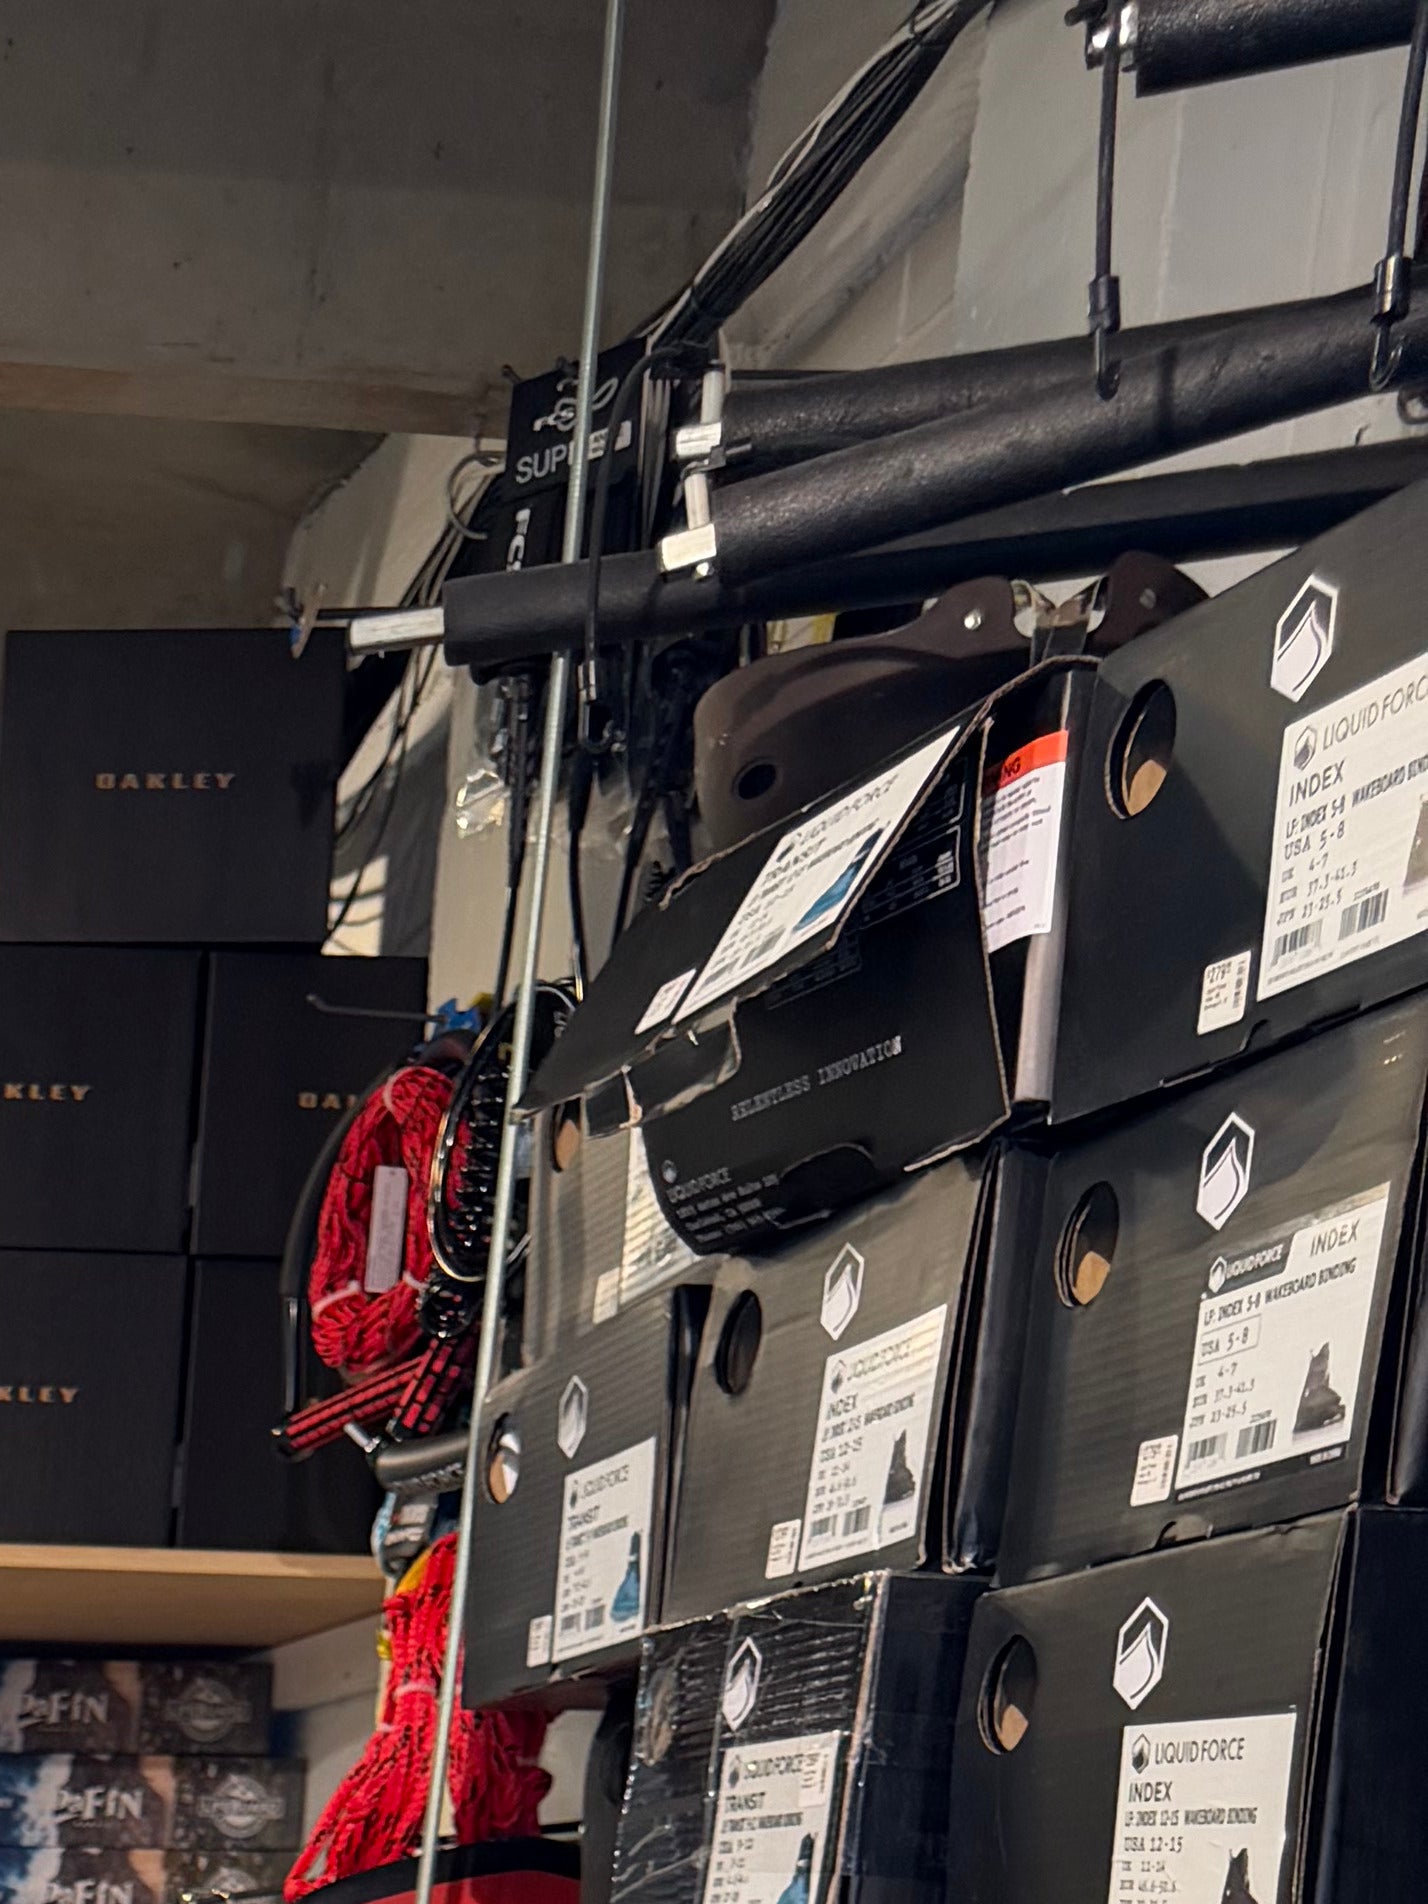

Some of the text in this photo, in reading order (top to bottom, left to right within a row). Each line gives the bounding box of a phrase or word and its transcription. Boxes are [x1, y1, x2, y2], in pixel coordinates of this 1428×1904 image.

[1381, 675, 1428, 720] FORC
[96, 773, 236, 790] OAKLEY
[1289, 759, 1345, 807] INDEX
[1284, 835, 1311, 860] USA
[817, 1035, 902, 1086] INNOVATION
[1310, 1218, 1360, 1257] INDEX
[1155, 1737, 1245, 1765] LIQUID FORCE
[1128, 1782, 1173, 1803] INDEX
